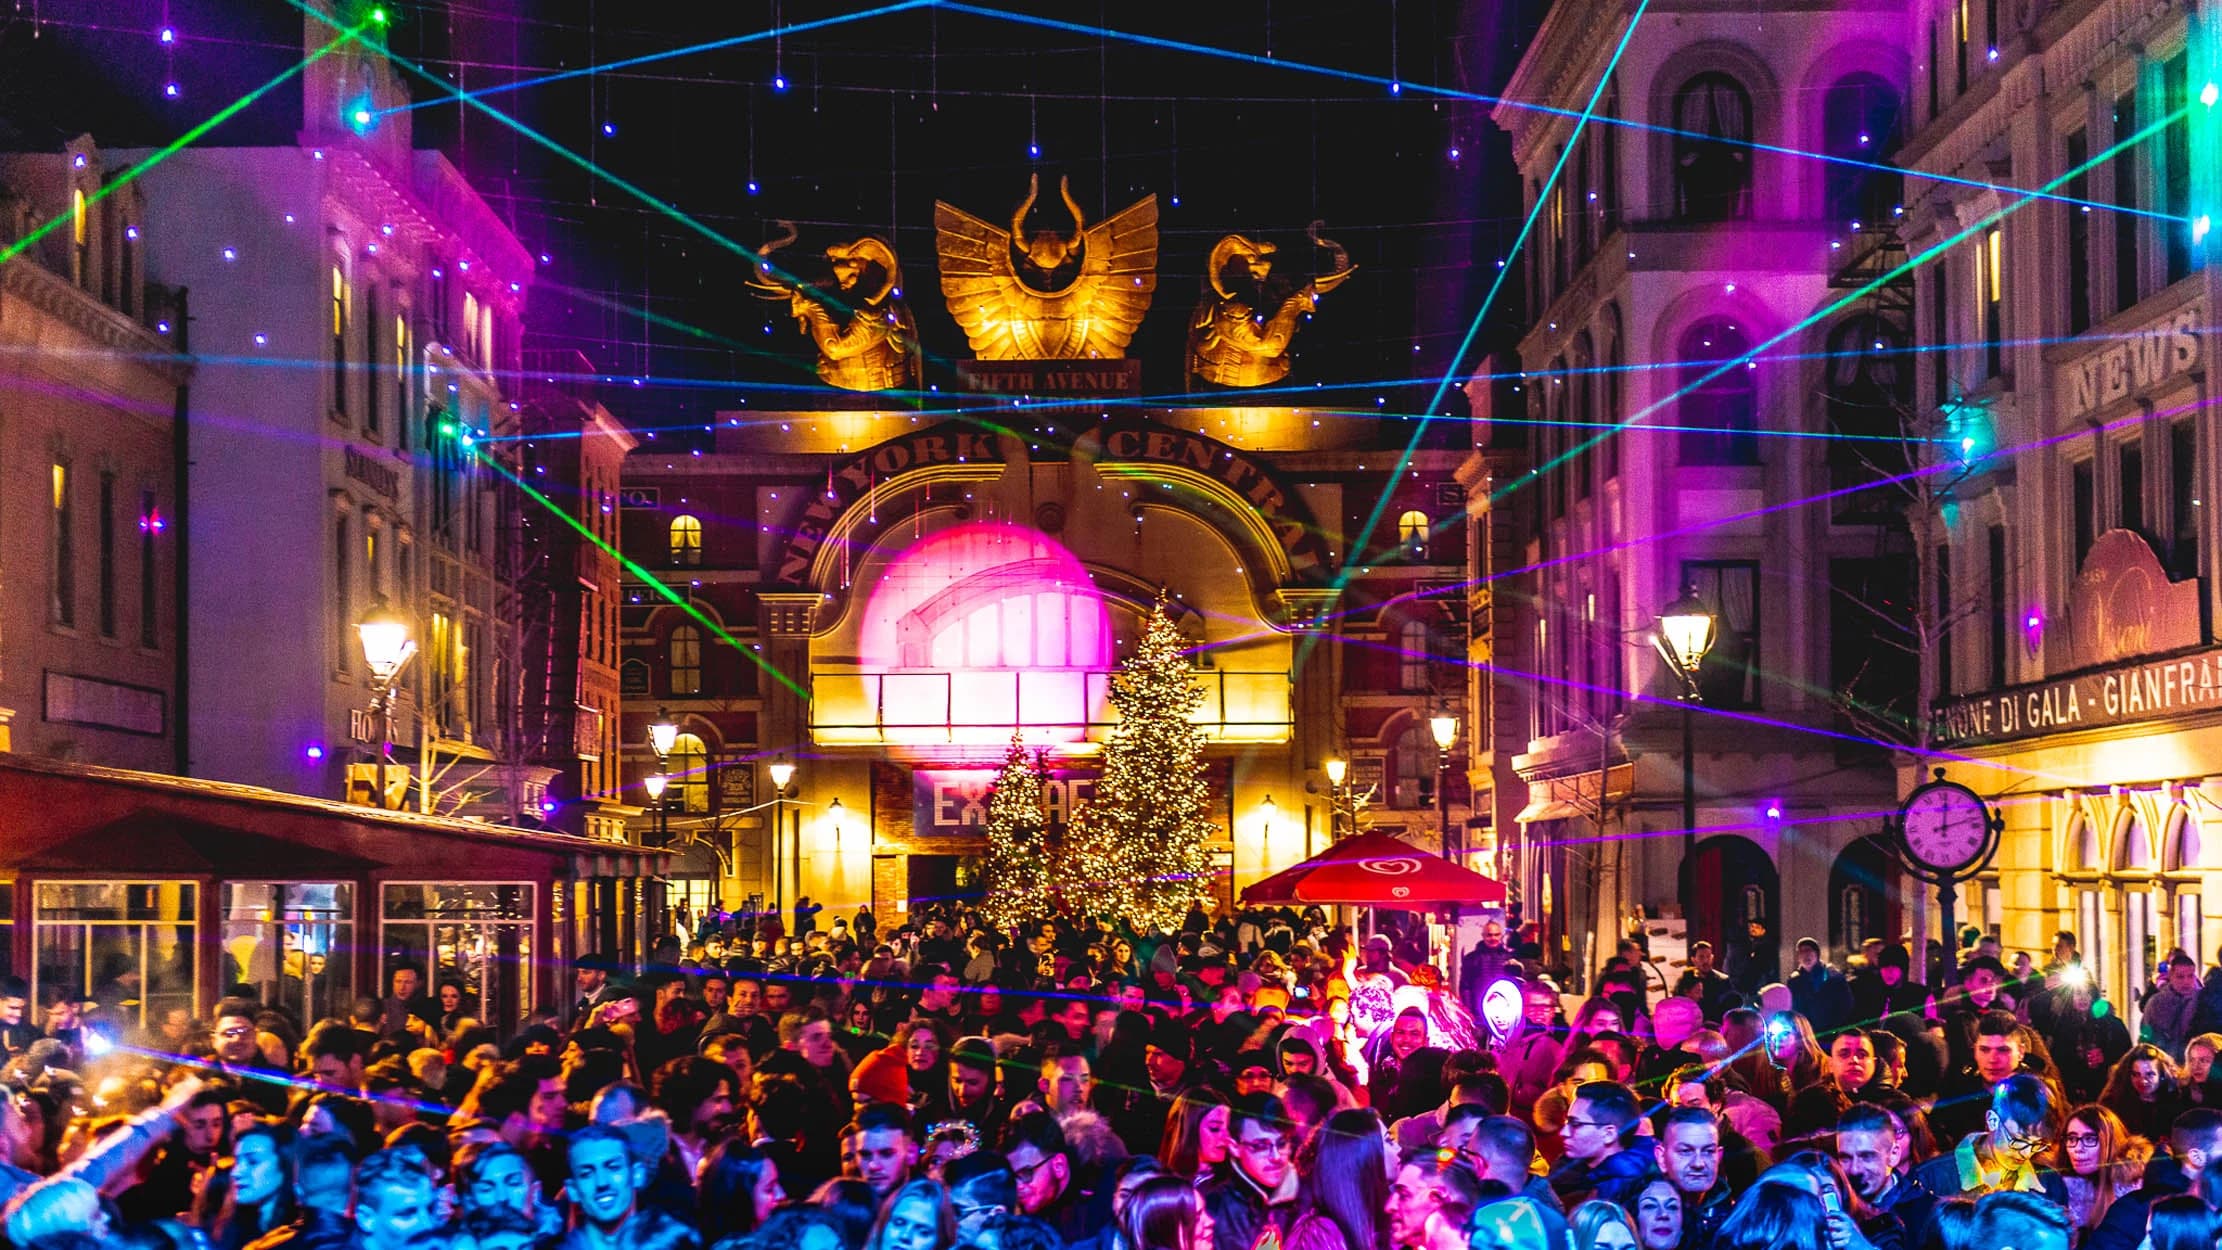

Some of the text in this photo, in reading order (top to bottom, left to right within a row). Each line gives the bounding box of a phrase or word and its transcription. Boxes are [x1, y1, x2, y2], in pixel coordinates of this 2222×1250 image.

[968, 372, 1129, 390] FIFTH AVENUE
[2071, 309, 2199, 417] NEWS
[777, 431, 1319, 584] NEW YORK CENTRAL
[2001, 697, 2020, 733] DI
[2026, 684, 2082, 728] GALA
